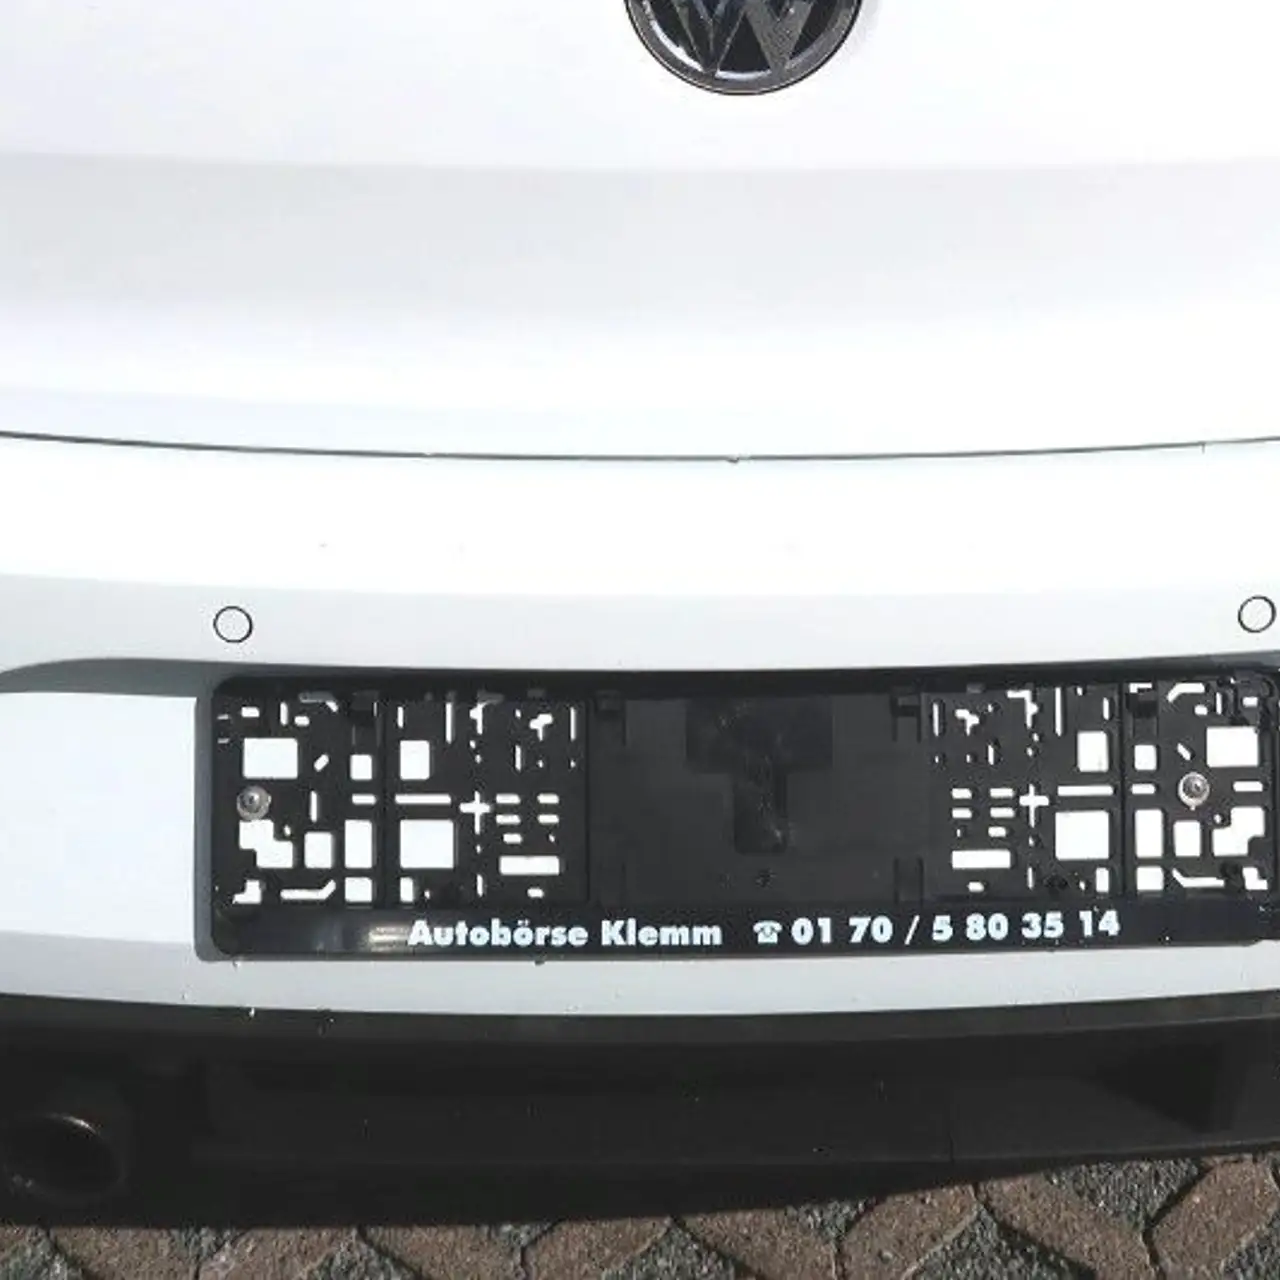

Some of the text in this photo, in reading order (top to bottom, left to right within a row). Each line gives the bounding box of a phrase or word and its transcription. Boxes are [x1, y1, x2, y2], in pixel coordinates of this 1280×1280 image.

[403, 909, 1121, 947] Autobörse Klemm 01 70 / 5 80 35 14
